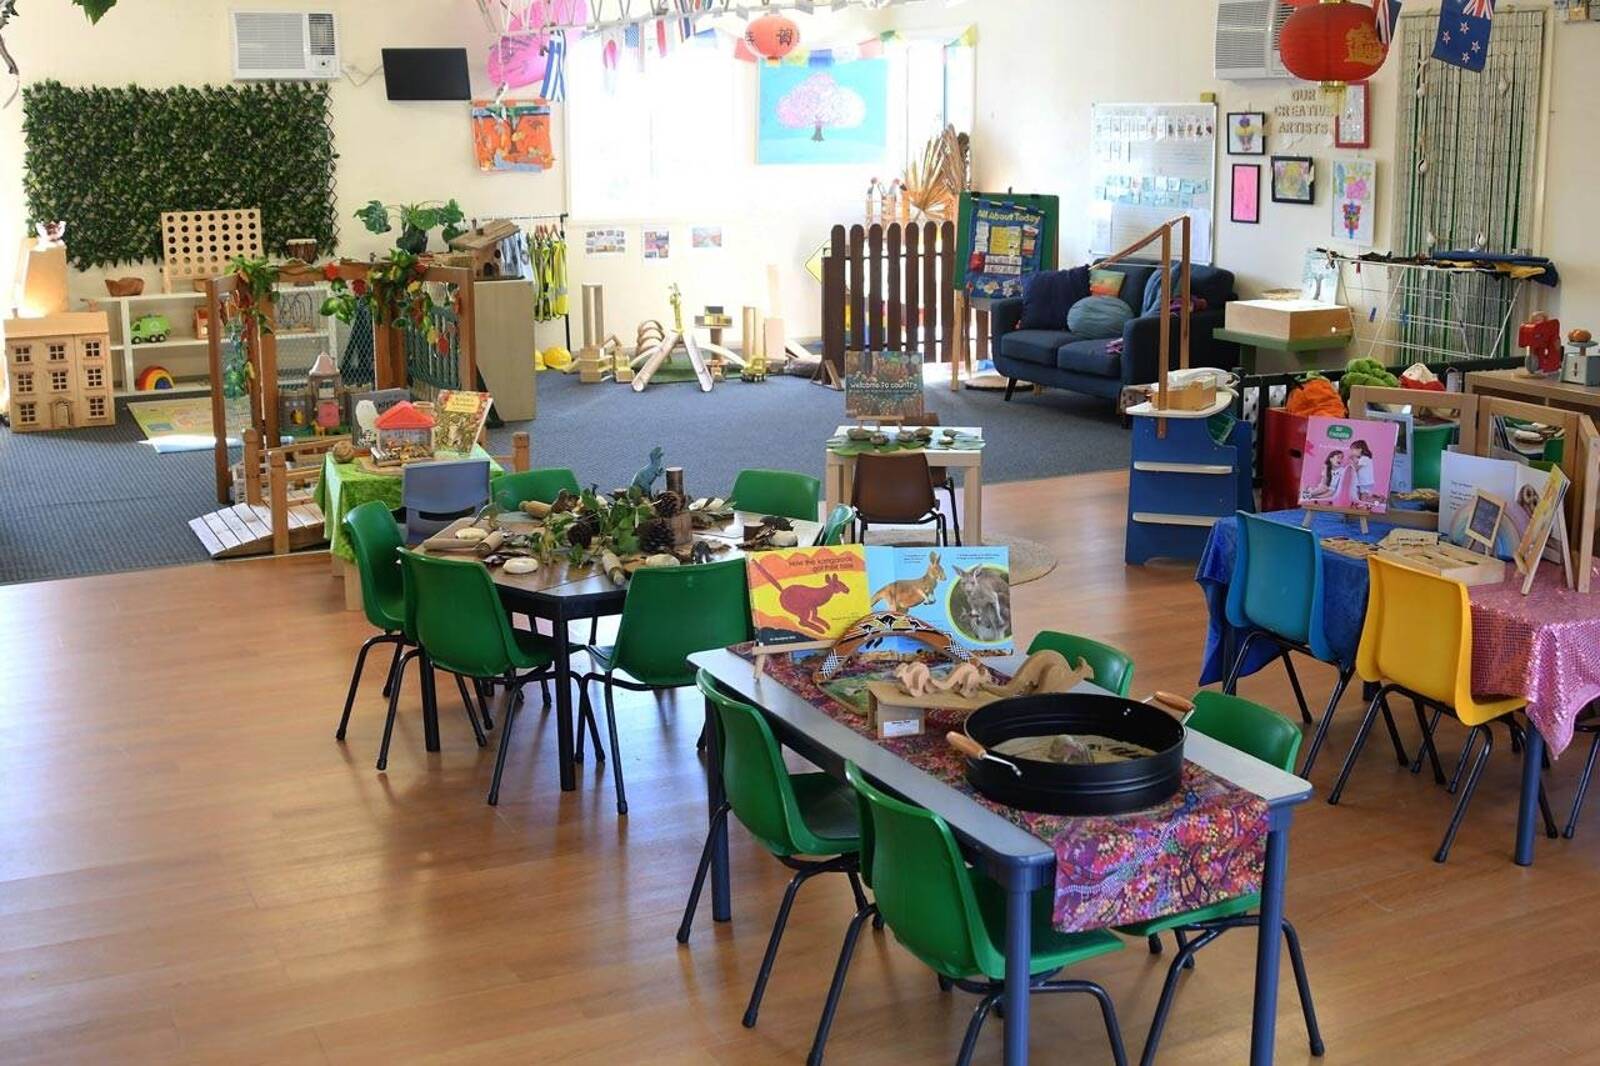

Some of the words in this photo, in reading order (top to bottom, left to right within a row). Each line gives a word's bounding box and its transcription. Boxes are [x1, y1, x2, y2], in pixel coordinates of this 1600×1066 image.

[1292, 89, 1317, 101] OUR
[1278, 122, 1329, 134] ARTISTS
[977, 209, 989, 219] All
[989, 211, 1014, 221] About
[1014, 213, 1041, 225] Today
